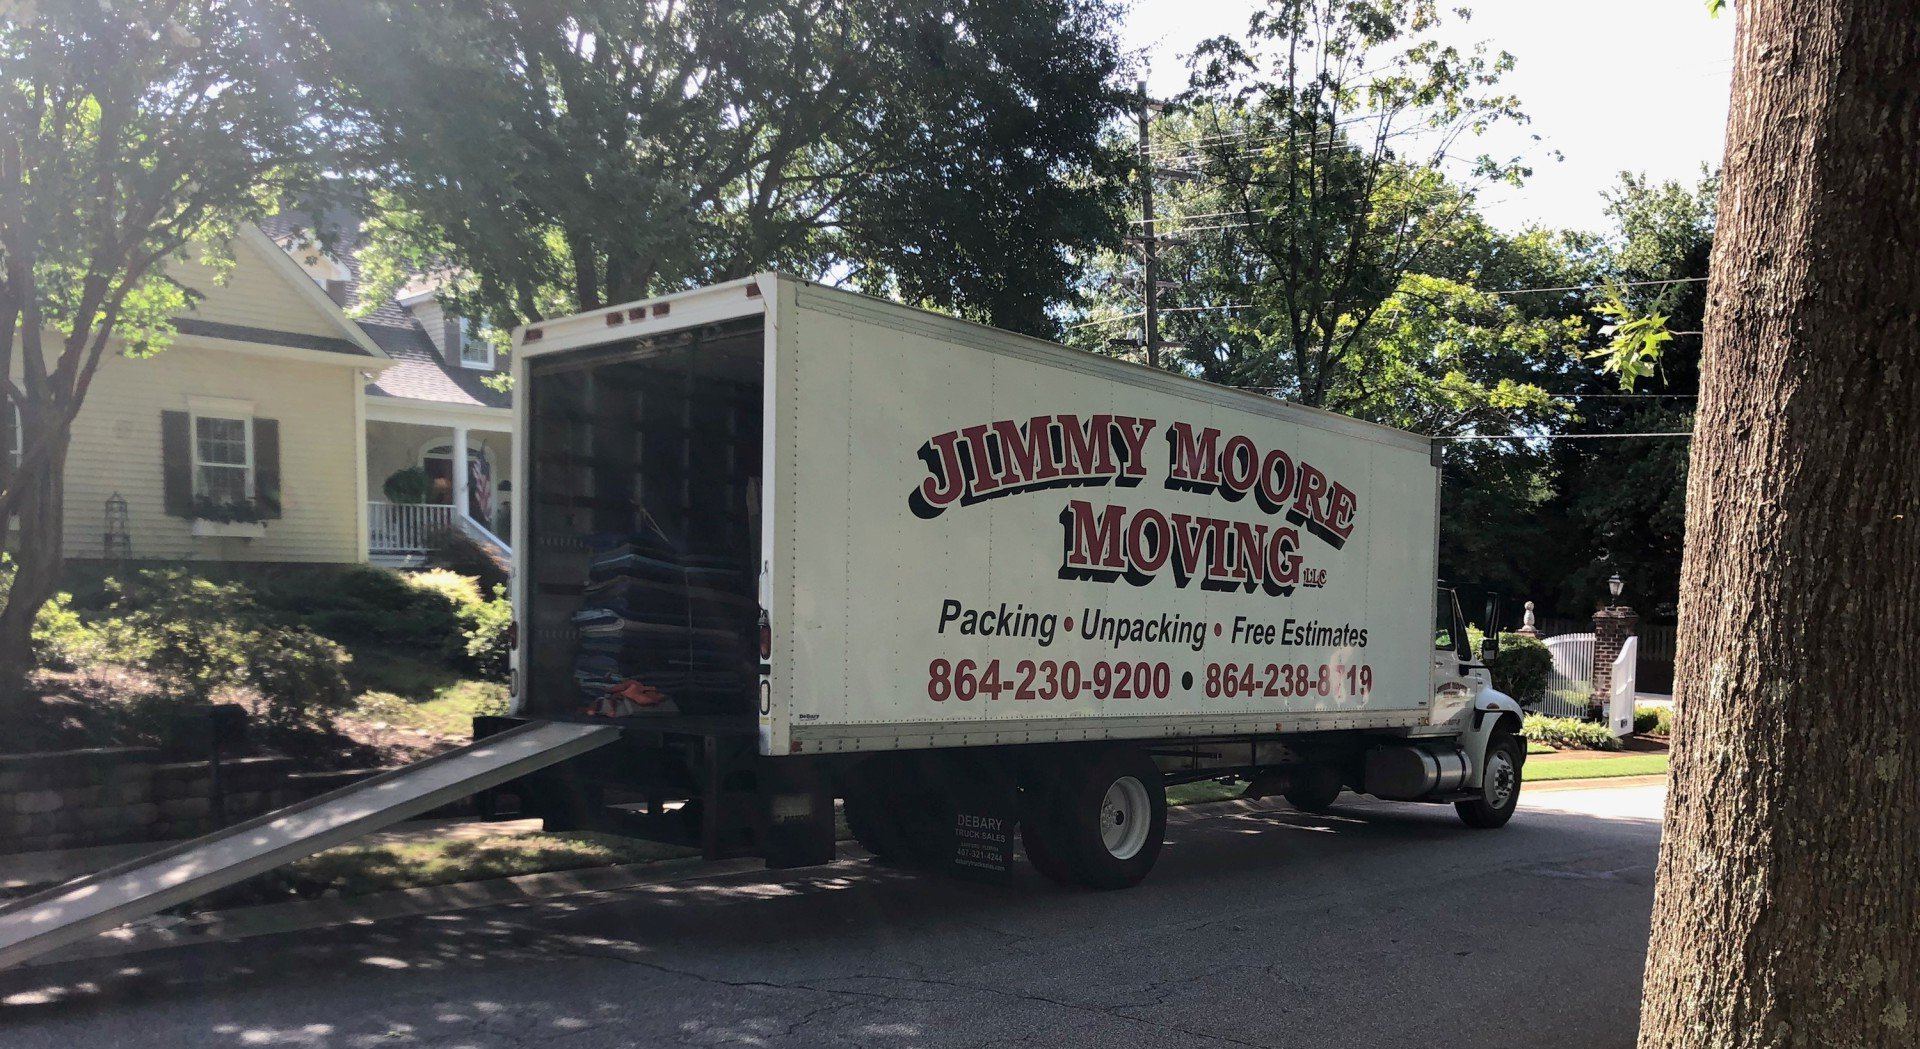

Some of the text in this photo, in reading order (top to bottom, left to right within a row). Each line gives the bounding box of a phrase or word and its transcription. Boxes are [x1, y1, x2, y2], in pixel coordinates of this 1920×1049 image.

[908, 414, 1357, 550] JIMMY MOORE
[1058, 500, 1327, 597] MOVING LLC
[938, 599, 1368, 651] Packing Unpacking Free Estimates
[928, 658, 1170, 702] 864-230-9200
[955, 828, 1006, 843] TRUCK SALES
[957, 814, 1003, 831] DEBARY
